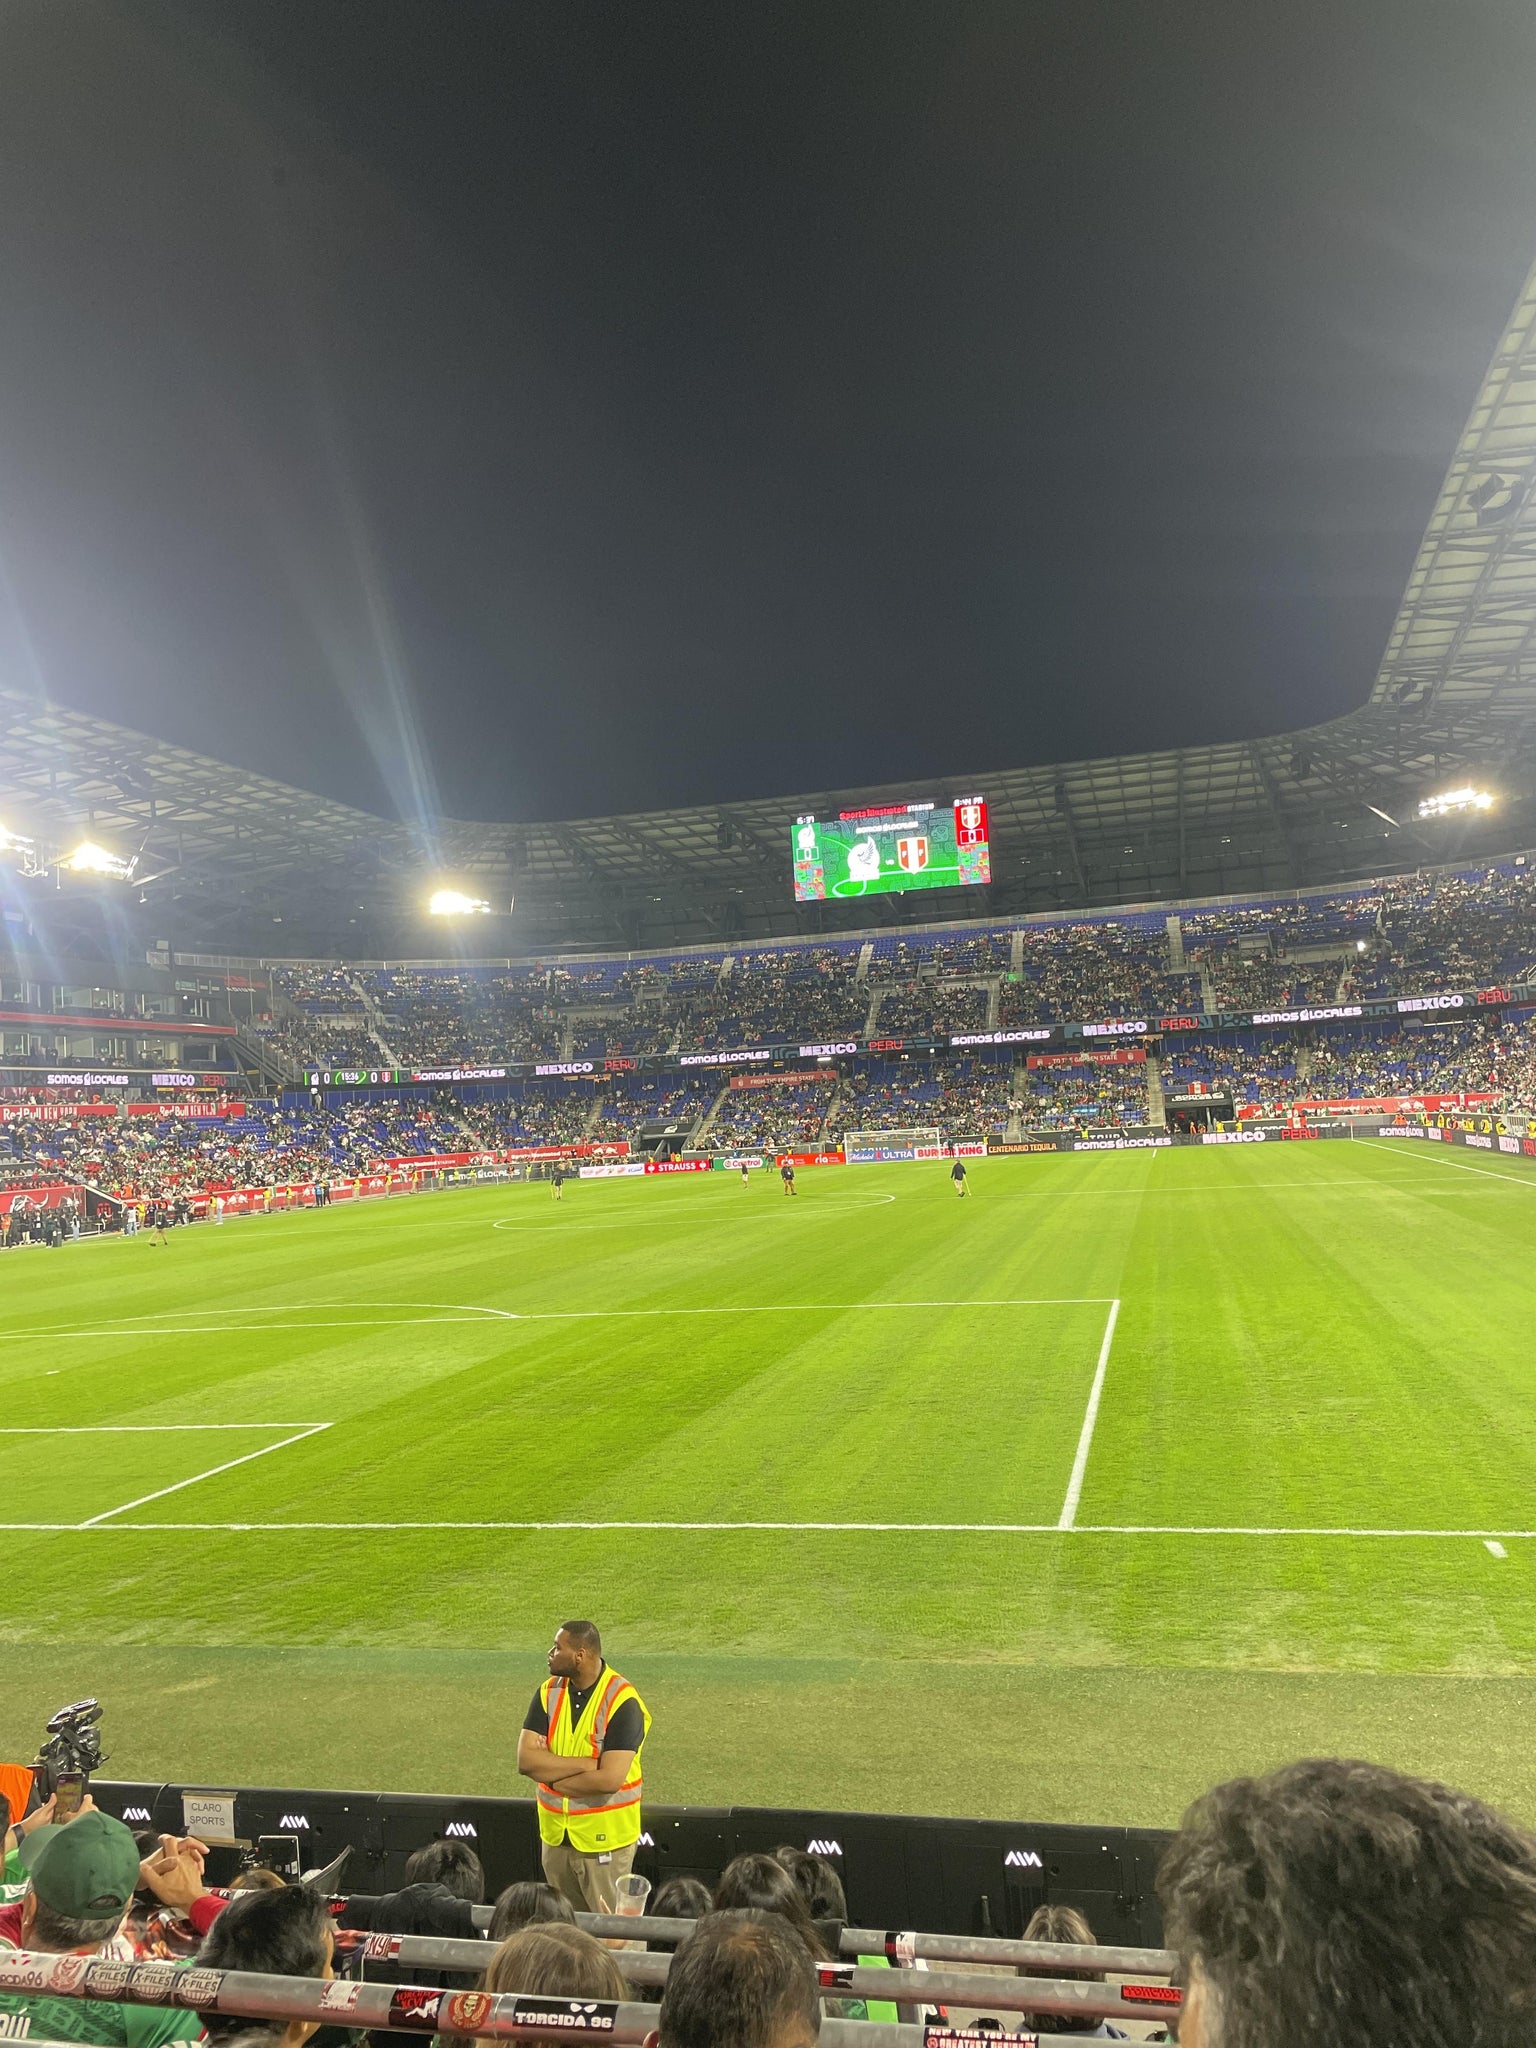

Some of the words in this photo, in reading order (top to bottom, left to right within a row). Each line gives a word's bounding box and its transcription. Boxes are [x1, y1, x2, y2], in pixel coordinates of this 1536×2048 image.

[804, 847, 811, 861] 0
[1397, 994, 1464, 1013] MEXICO
[1477, 989, 1511, 1005] PERU
[1160, 1017, 1199, 1031] PERU
[1252, 1012, 1299, 1024] SOMOS
[1309, 1006, 1362, 1020] LOCALES
[951, 1035, 994, 1046] SOMOS
[1002, 1029, 1050, 1042] LOCALES
[1082, 1021, 1148, 1037] MEXICO
[680, 1055, 718, 1066] SOMOS
[726, 1051, 770, 1062] LOCALES
[800, 1042, 857, 1057] MEXICO
[868, 1040, 903, 1051] PERU
[460, 1069, 506, 1079] LOCALES
[535, 1062, 593, 1075] MEXICO
[604, 1058, 636, 1071] PERU
[47, 1074, 83, 1085] SOMOS
[91, 1074, 129, 1085] LOCALES
[152, 1074, 195, 1086] MEXICO
[203, 1074, 226, 1087] PERU
[324, 1072, 330, 1084] 0
[341, 1072, 359, 1080] 15:36
[370, 1072, 378, 1083] 0
[175, 1105, 188, 1116] Bull
[1203, 1131, 1266, 1144] MEXICO
[1281, 1128, 1318, 1140] PERU
[988, 1144, 1029, 1153] CENTENARIO
[1030, 1142, 1058, 1151] TEQUILA
[1073, 1140, 1115, 1150] SOMOS
[1125, 1137, 1172, 1147] LOCALES
[882, 1150, 914, 1159] ULTRA
[958, 1145, 984, 1156] KING
[815, 1154, 829, 1164] ria
[658, 1162, 696, 1172] STRAUSS
[191, 1802, 222, 1813] CLARO
[189, 1815, 225, 1826] SPORTS
[515, 2012, 586, 2028] TORCIDA
[591, 2016, 613, 2029] 96
[928, 2027, 952, 2036] NEW
[955, 2029, 980, 2038] YORK
[1020, 2033, 1037, 2041] MY
